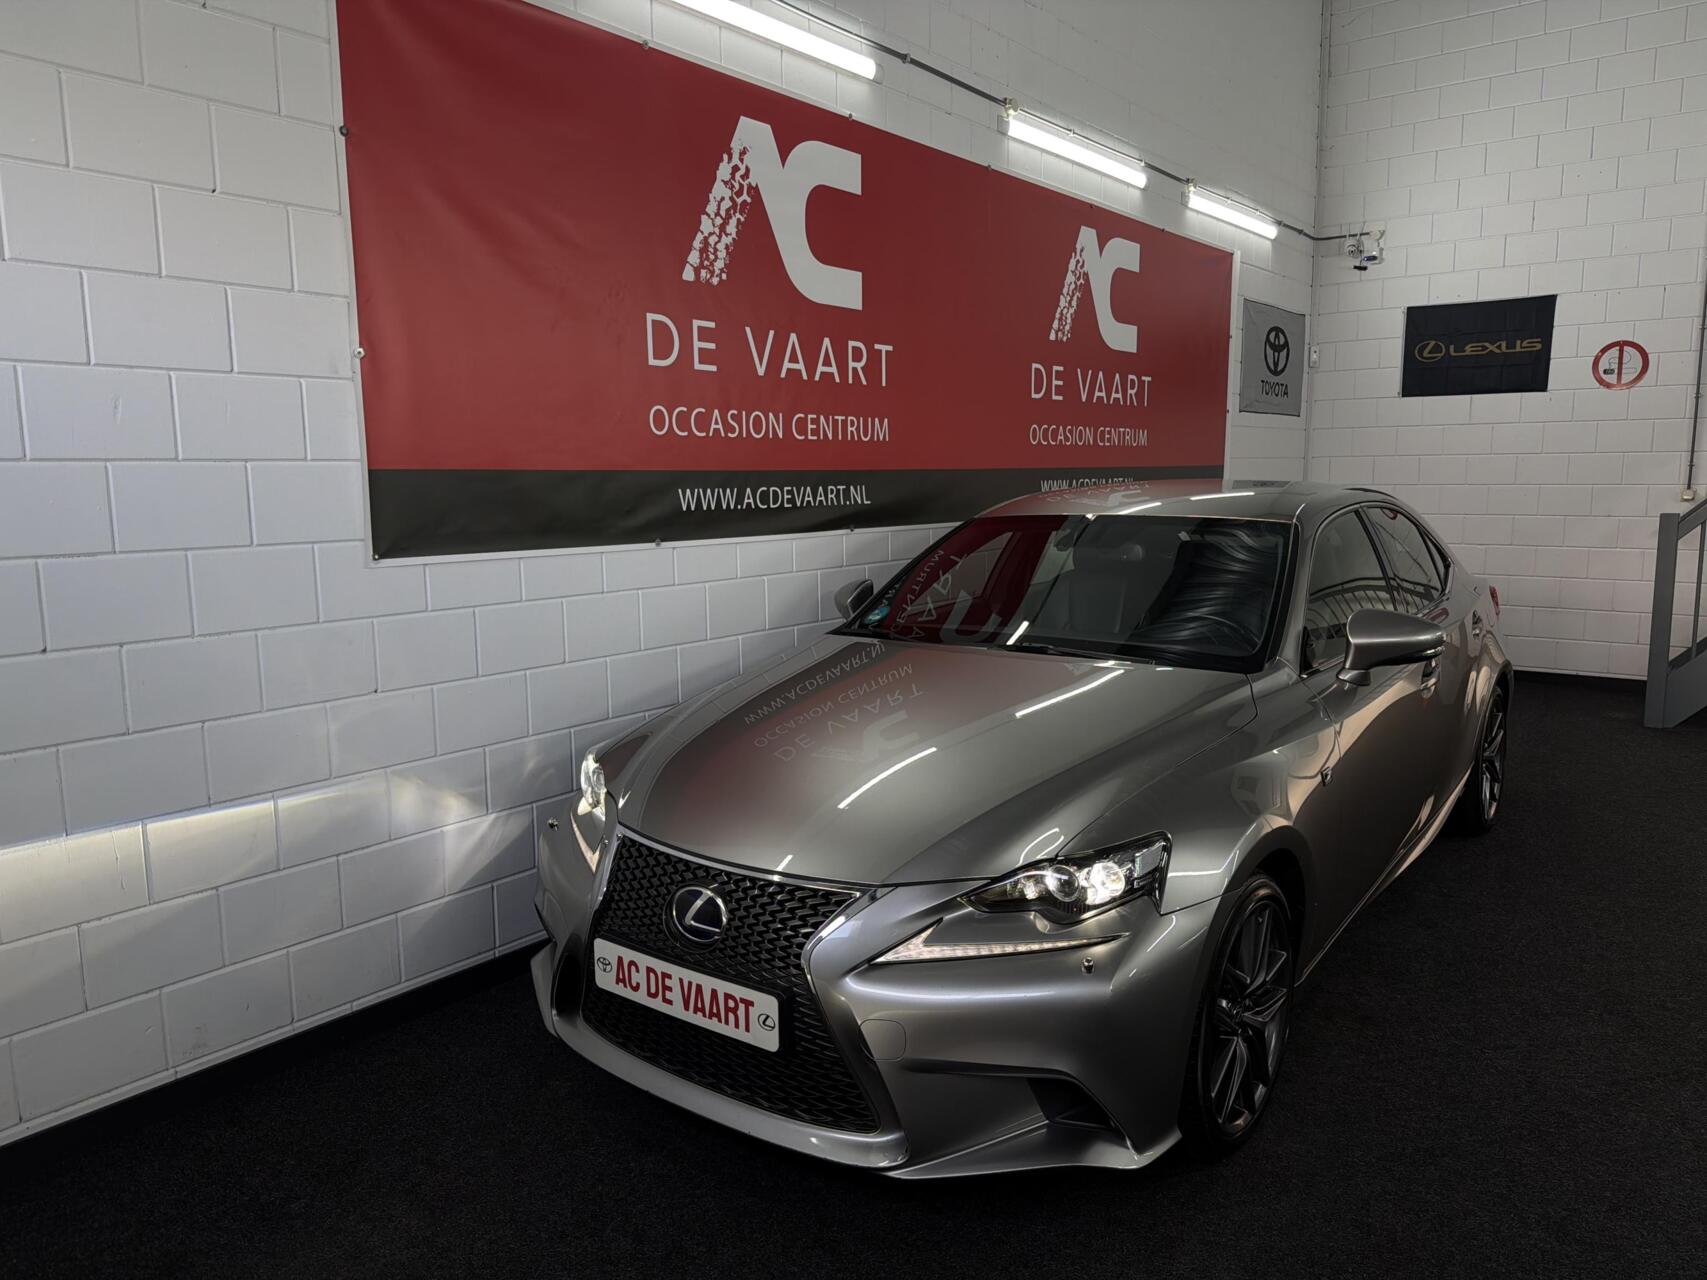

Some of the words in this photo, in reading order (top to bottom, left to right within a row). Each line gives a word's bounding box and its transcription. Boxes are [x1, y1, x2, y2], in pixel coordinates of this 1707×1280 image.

[646, 312, 717, 372] DE
[745, 326, 893, 387] VAART
[1449, 338, 1542, 356] LEXUS
[1031, 362, 1064, 401] DE
[1077, 368, 1152, 407] VAART
[1260, 379, 1289, 399] TOYOTA
[649, 405, 783, 439] OCCASION
[791, 413, 889, 442] CENTRUM
[1029, 424, 1094, 446] OCCASION
[1097, 426, 1148, 447] CENTRUM
[678, 485, 871, 512] WWW.ACDEVAART.NL
[615, 955, 641, 992] AC
[646, 965, 673, 1006] DE
[678, 977, 754, 1033] VAART
